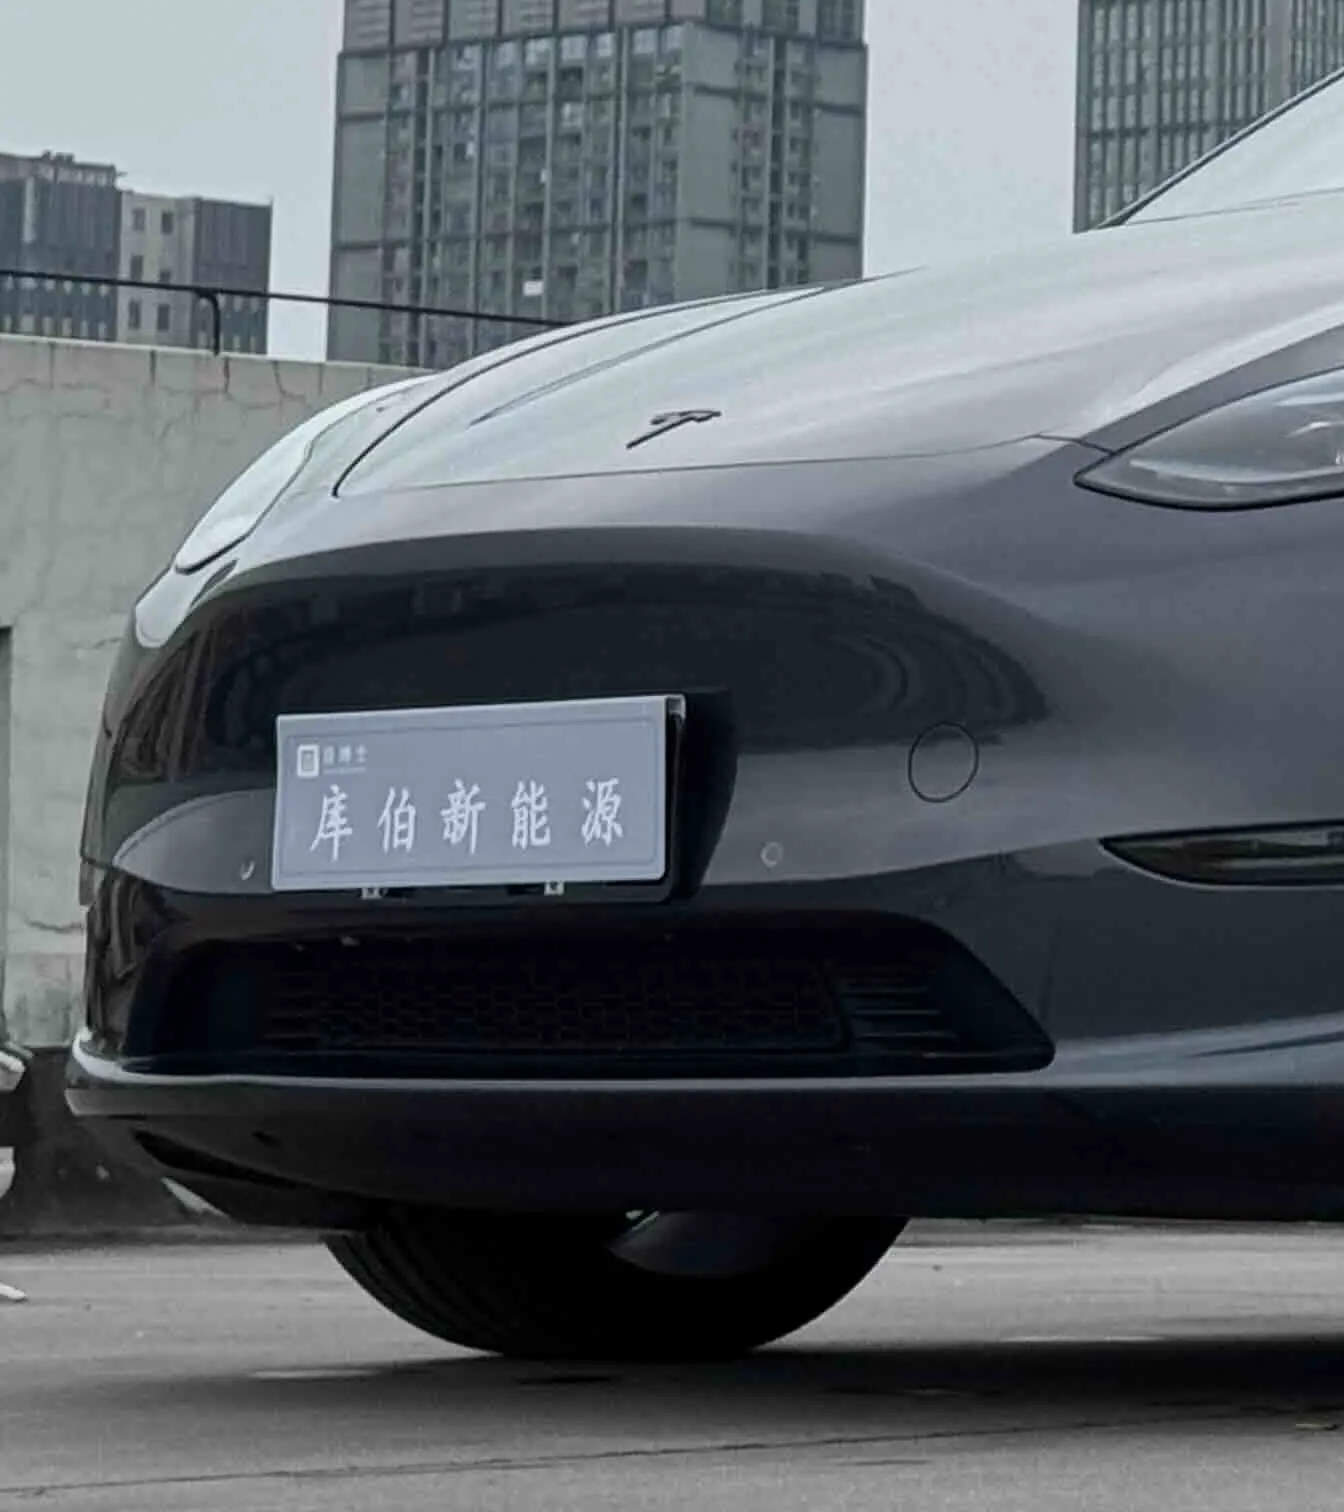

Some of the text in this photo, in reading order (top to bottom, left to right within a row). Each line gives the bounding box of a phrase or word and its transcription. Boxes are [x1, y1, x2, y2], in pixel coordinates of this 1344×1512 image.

[309, 776, 625, 862] 库伯新能源
